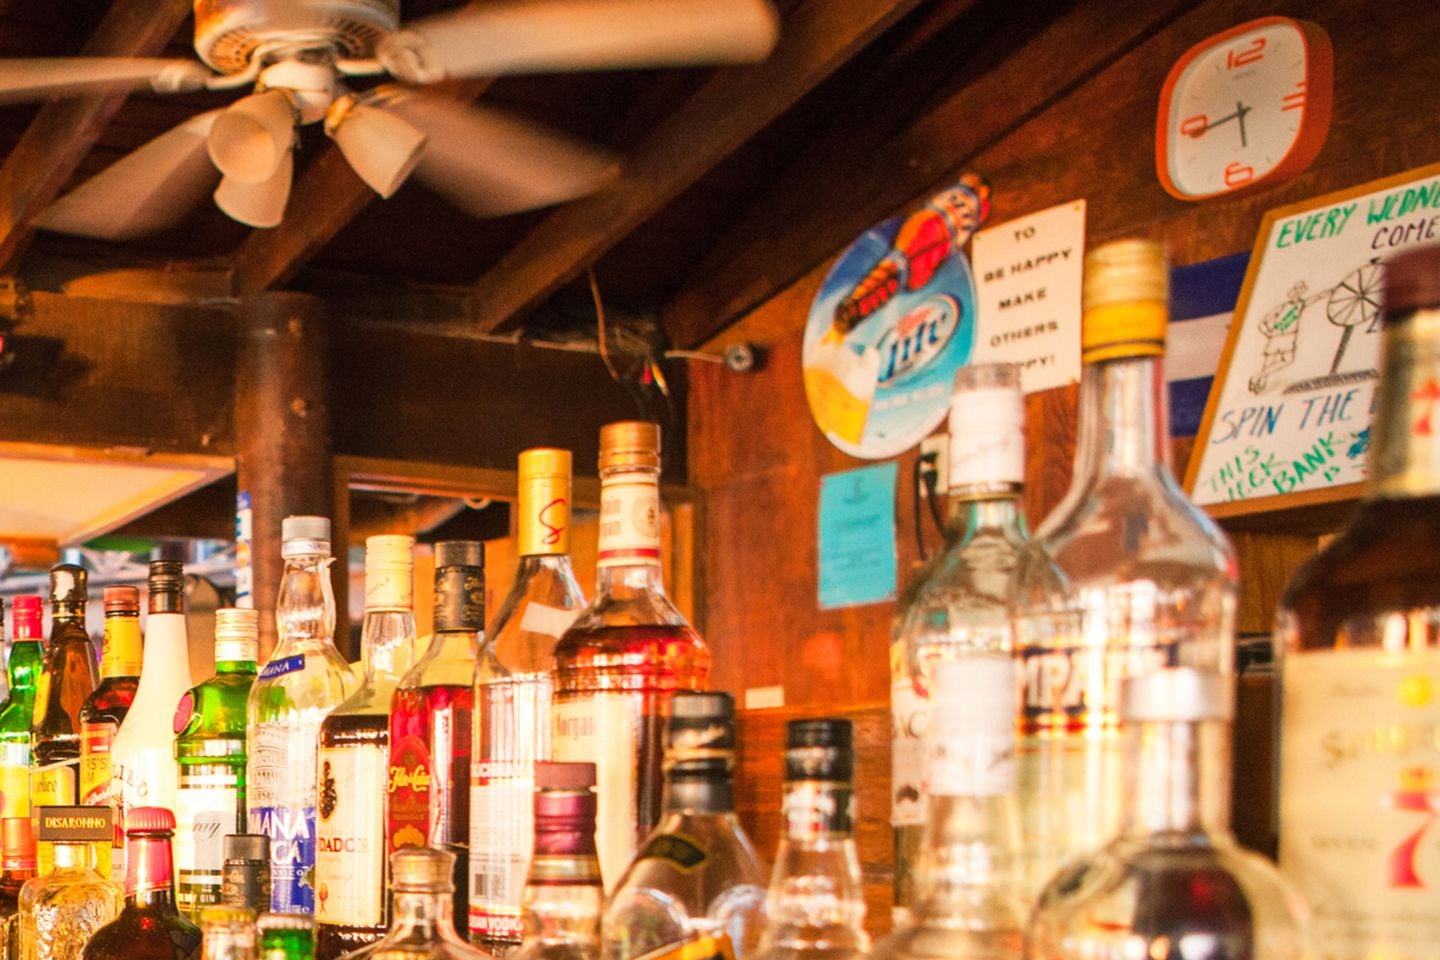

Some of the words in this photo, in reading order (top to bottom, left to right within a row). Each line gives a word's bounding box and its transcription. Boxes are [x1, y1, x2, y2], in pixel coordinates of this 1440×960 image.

[1226, 36, 1267, 71] 12
[1224, 162, 1254, 188] 6
[1013, 226, 1036, 243] TO
[1276, 202, 1358, 250] EVERY
[1371, 214, 1440, 250] COME
[983, 267, 1006, 284] BE
[1010, 248, 1073, 275] HAPPY
[997, 288, 1048, 311] MAKE
[990, 319, 1059, 348] OTHERS
[1211, 402, 1285, 445] SPIN
[1299, 388, 1361, 431] THE
[1272, 431, 1346, 494] BANK
[44, 814, 107, 830] DISARONNO
